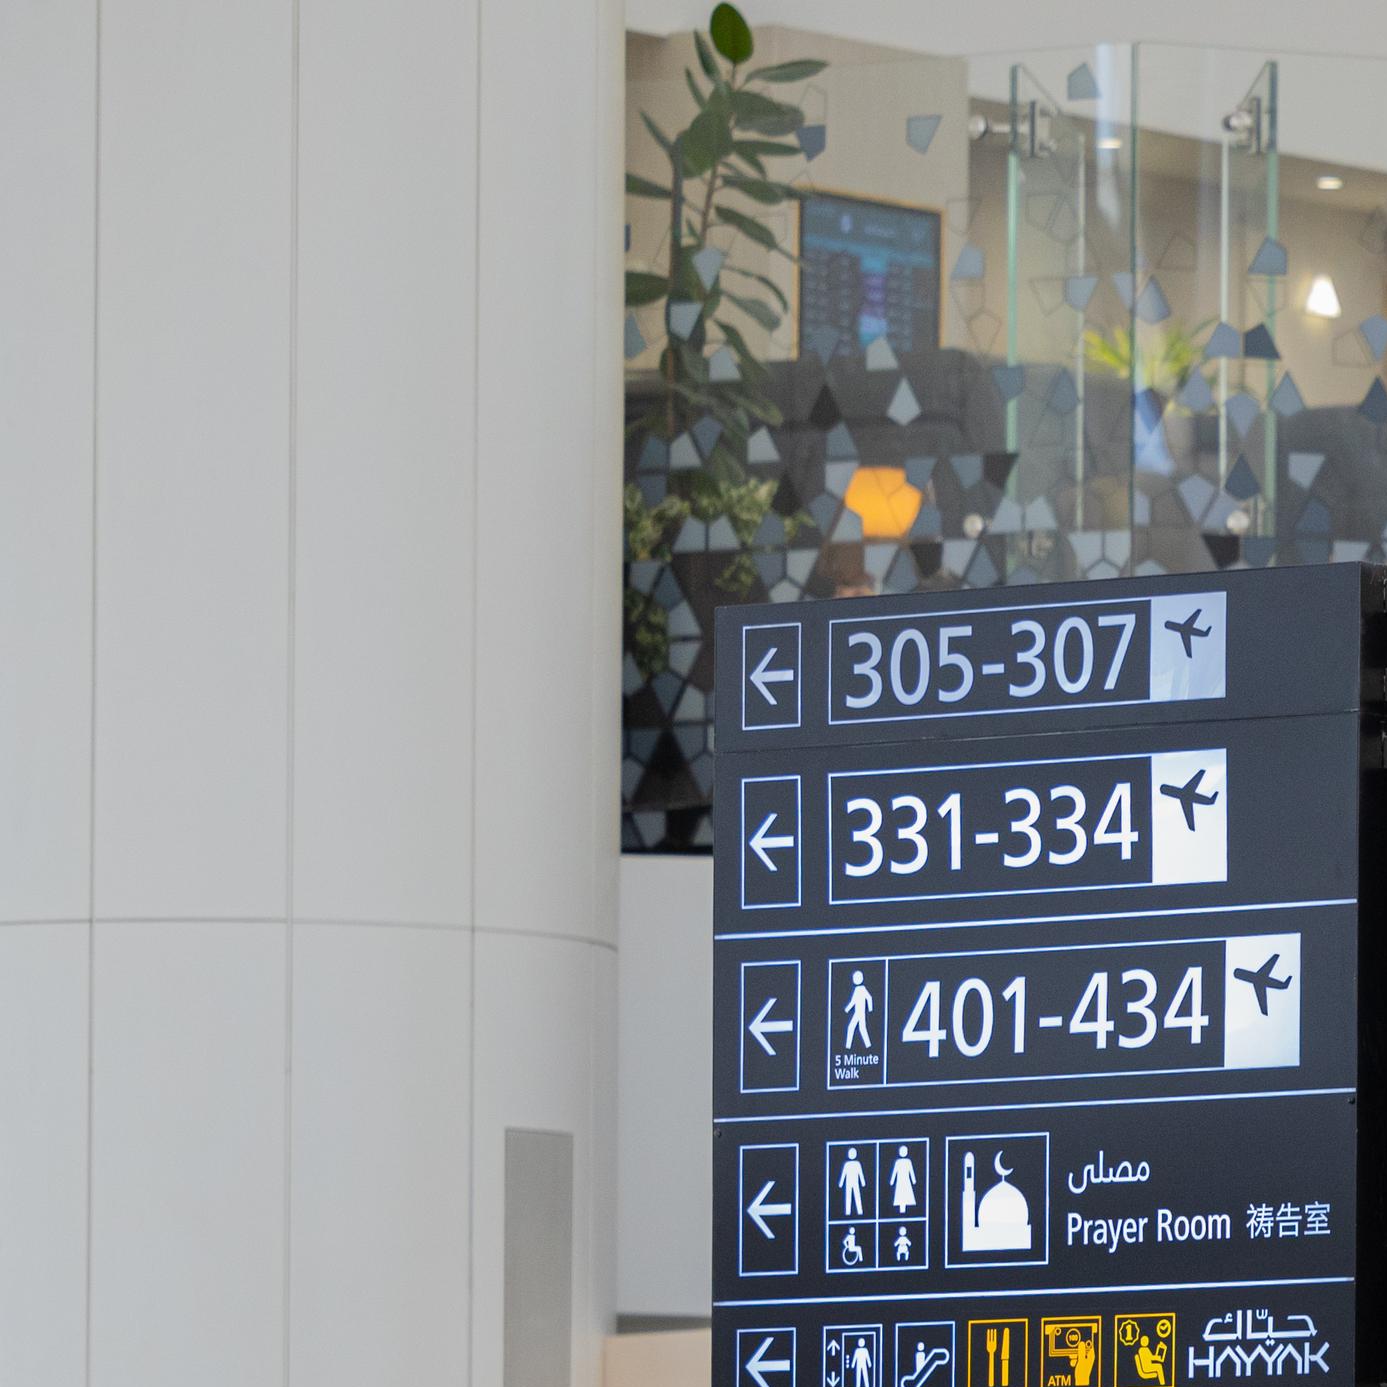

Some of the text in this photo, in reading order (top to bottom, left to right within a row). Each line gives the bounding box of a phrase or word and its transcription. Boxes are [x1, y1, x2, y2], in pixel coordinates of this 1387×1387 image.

[844, 613, 1137, 709] 305-307
[845, 783, 1138, 876] 331-334
[902, 967, 1209, 1057] 401-434
[835, 1054, 879, 1066] 5 Minute
[835, 1067, 859, 1079] Walk
[1068, 1150, 1150, 1194] مصلى
[1068, 1201, 1330, 1253] Prayer Room 祷告室
[1048, 1375, 1071, 1386] ATM
[1188, 1339, 1329, 1378] HAYYAK
